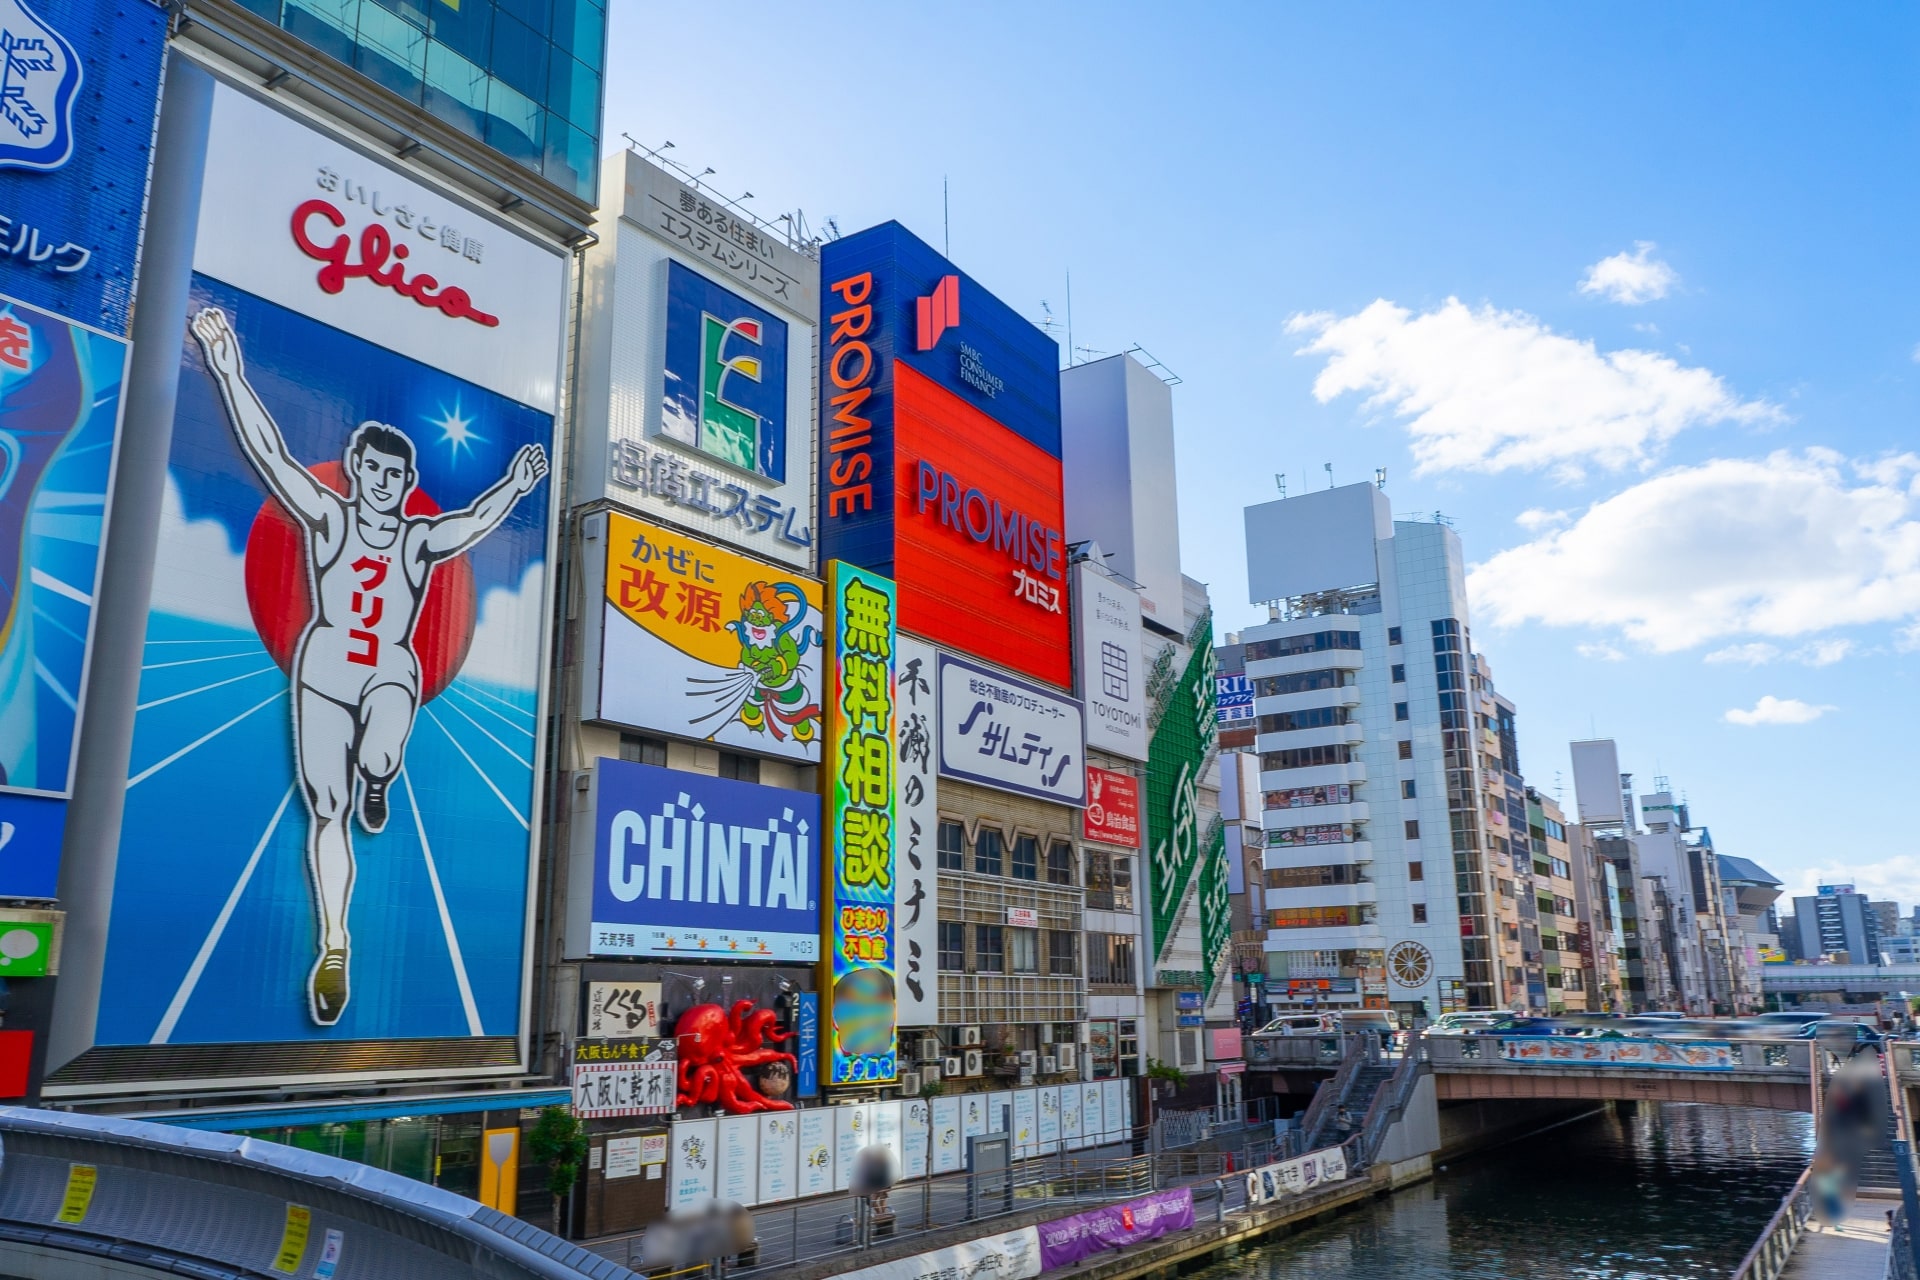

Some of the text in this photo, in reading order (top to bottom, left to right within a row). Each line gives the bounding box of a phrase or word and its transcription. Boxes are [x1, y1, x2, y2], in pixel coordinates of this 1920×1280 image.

[317, 165, 485, 264] おいしさと健康
[679, 189, 774, 259] 夢ある住まい
[291, 199, 499, 327] Glico
[660, 211, 789, 300] エステムシリーズ
[959, 340, 983, 365] SMBC
[959, 354, 1005, 392] CONSUMER
[828, 271, 872, 518] PROMISE
[959, 368, 996, 399] FINANCE
[918, 458, 1062, 580] PROMISE
[631, 534, 716, 583] かぜに
[346, 555, 392, 667] グリコ
[619, 564, 722, 633] 改源
[1012, 567, 1062, 614] プロミス
[969, 678, 1066, 718] 総合不動産のプロデューサー
[844, 576, 892, 890] 無料相談
[978, 721, 1053, 769] サムティ
[608, 792, 810, 911] CHINTAI
[841, 907, 888, 933] ひまわり
[844, 934, 888, 961] 不動産
[603, 988, 647, 1030] くくる
[576, 1043, 650, 1060] 大阪もんを食す
[578, 1070, 662, 1109] 大阪に乾杯
